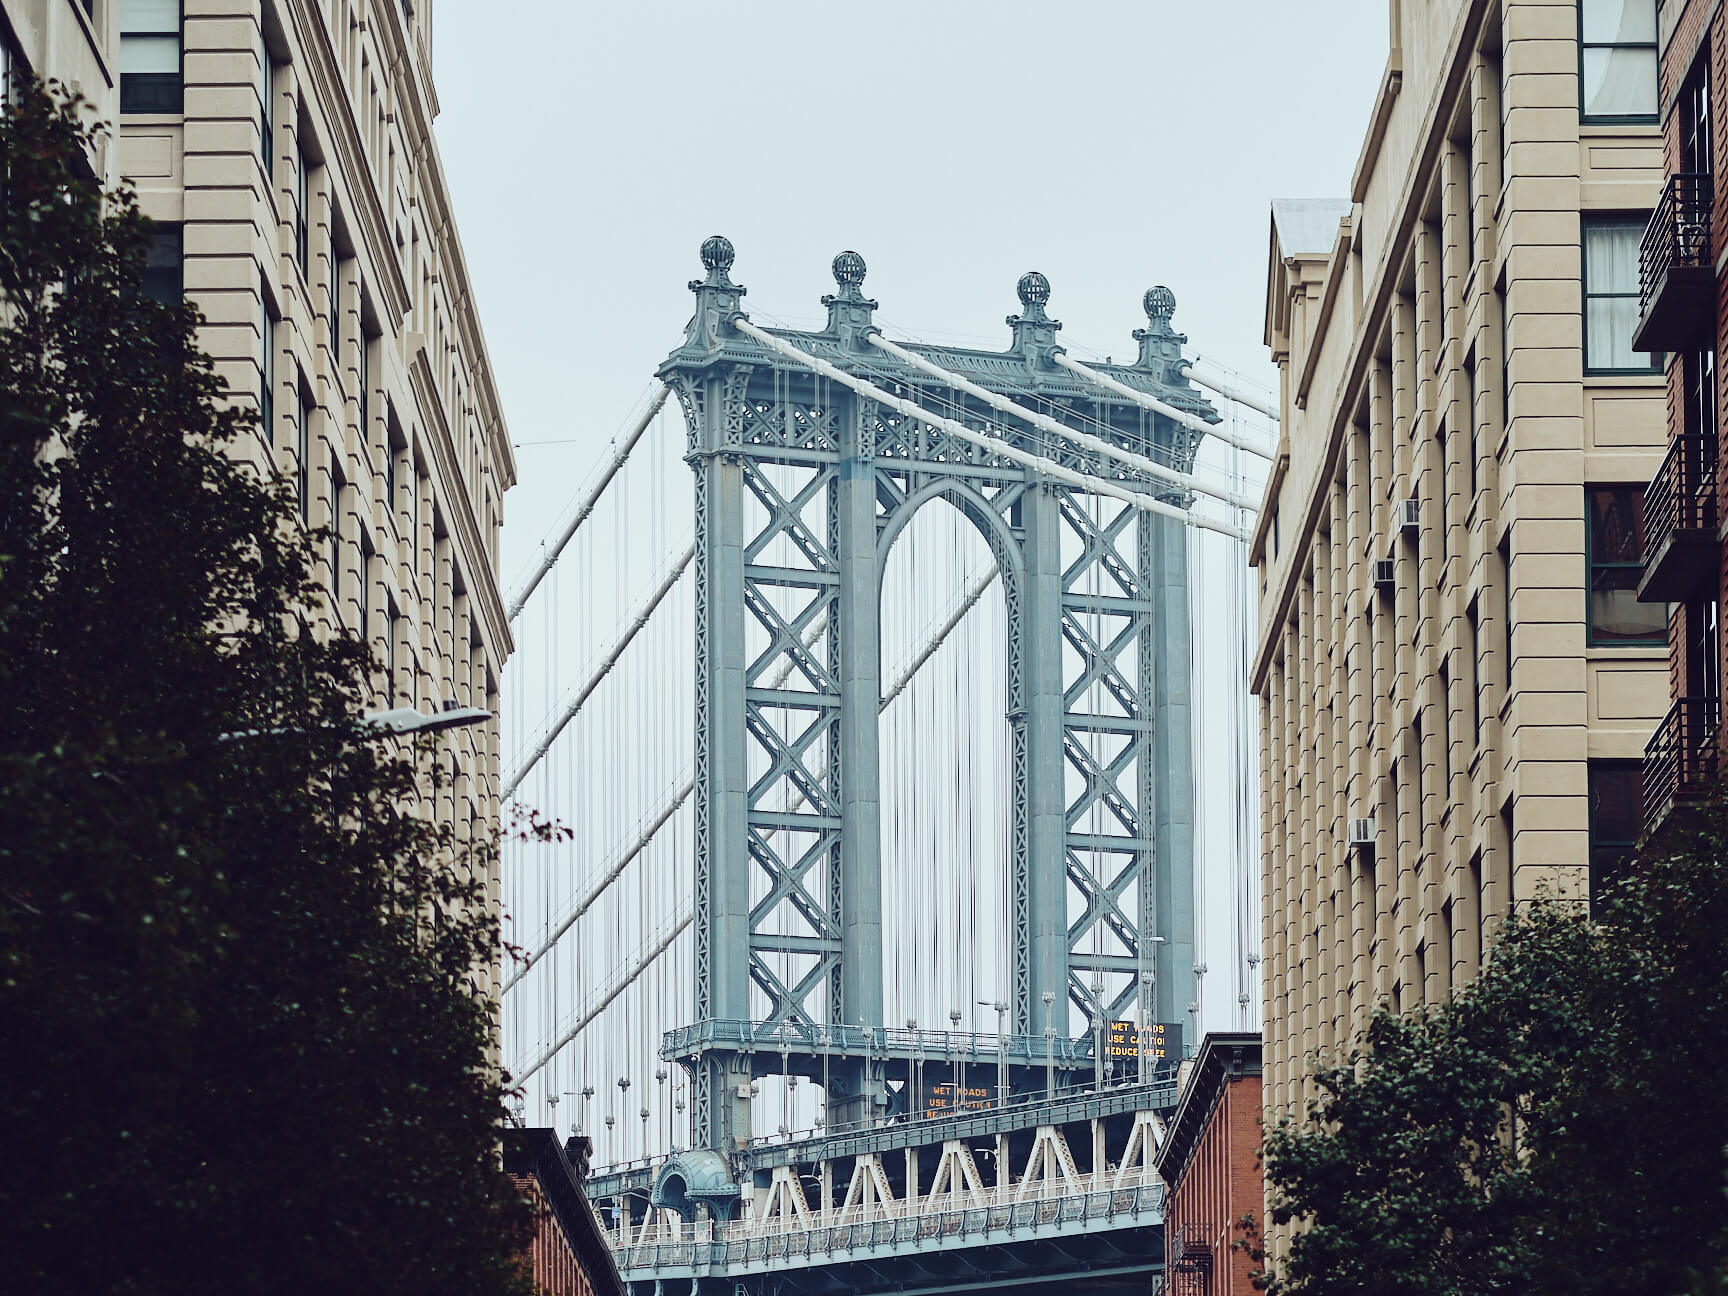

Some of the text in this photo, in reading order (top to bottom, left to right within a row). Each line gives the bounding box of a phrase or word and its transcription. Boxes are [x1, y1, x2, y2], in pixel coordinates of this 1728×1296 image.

[1111, 1023, 1165, 1034] WET RADS
[933, 1086, 951, 1096] WET
[929, 1098, 947, 1108] USE
